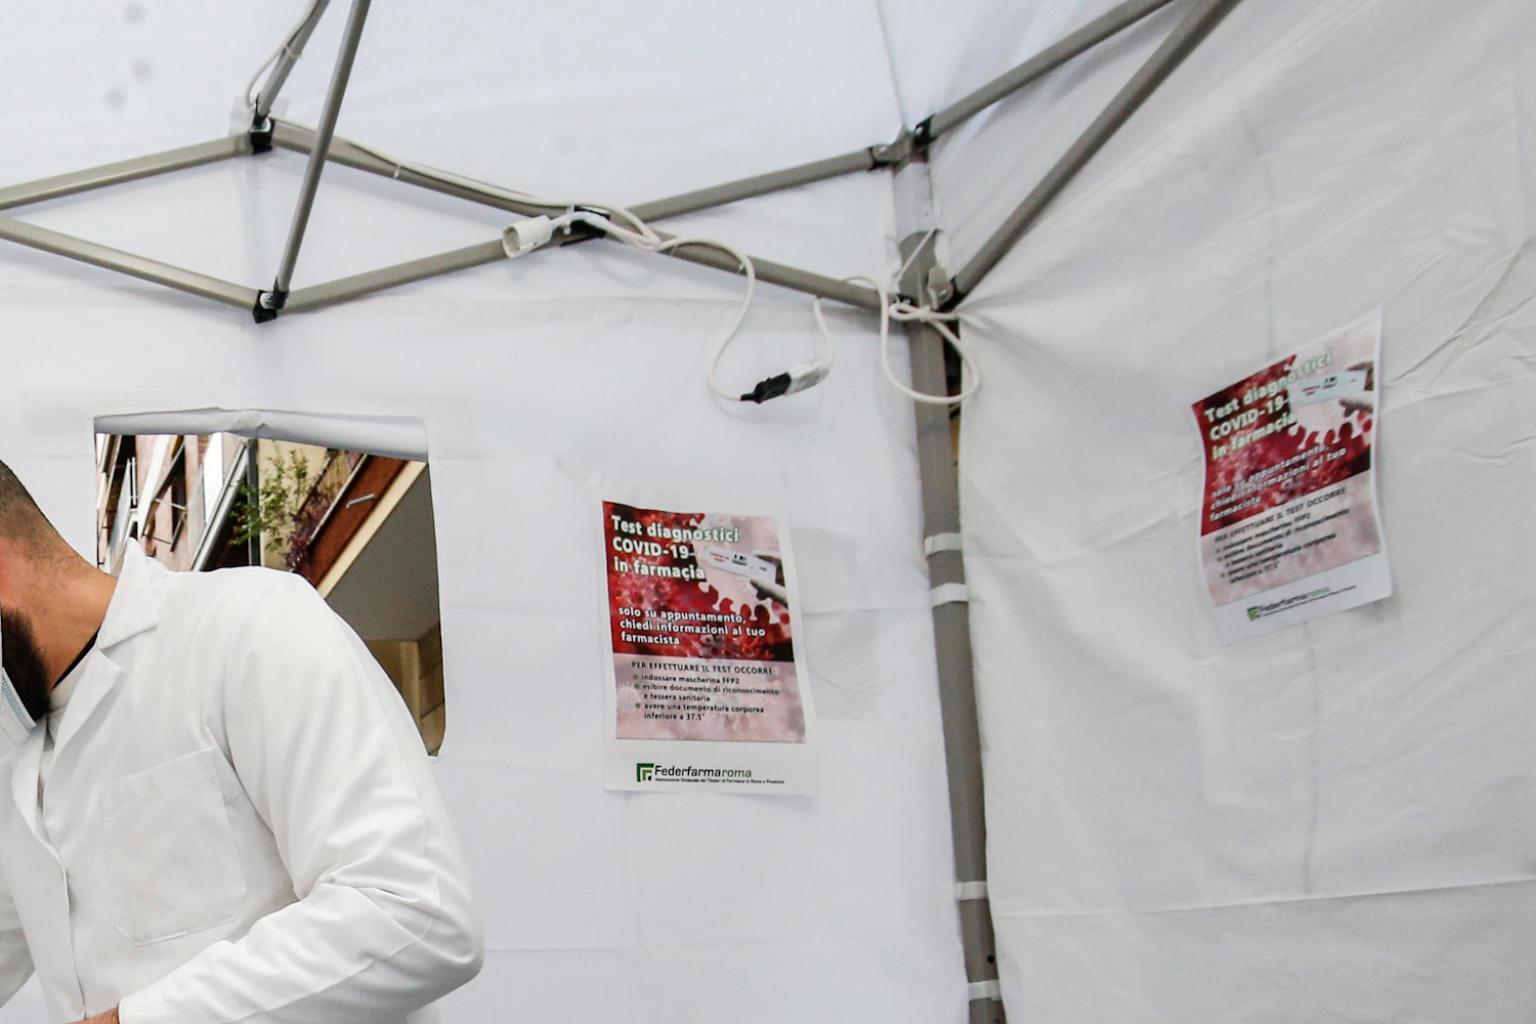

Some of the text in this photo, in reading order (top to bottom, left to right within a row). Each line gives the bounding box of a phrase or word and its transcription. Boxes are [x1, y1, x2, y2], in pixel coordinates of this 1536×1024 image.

[1204, 353, 1331, 422] Test diagnostici
[1210, 396, 1285, 440] COVID-19
[611, 515, 739, 542] Test diagnostici
[613, 537, 690, 559] COVID-19
[614, 557, 705, 580] in farmacia
[618, 607, 746, 624] solo su appuntamento,
[620, 619, 653, 630] chiedi
[656, 623, 728, 635] informazioni
[732, 626, 742, 635] al
[621, 632, 680, 645] farmacista
[649, 663, 699, 672] EFFETTUARE
[641, 674, 676, 682] indossare
[679, 676, 720, 684] mascherina
[669, 685, 711, 693] documento
[723, 688, 779, 696] riconoscimento
[644, 712, 677, 720] inferiore
[683, 705, 729, 713] temperatura
[654, 765, 752, 778] Federfarmaroma
